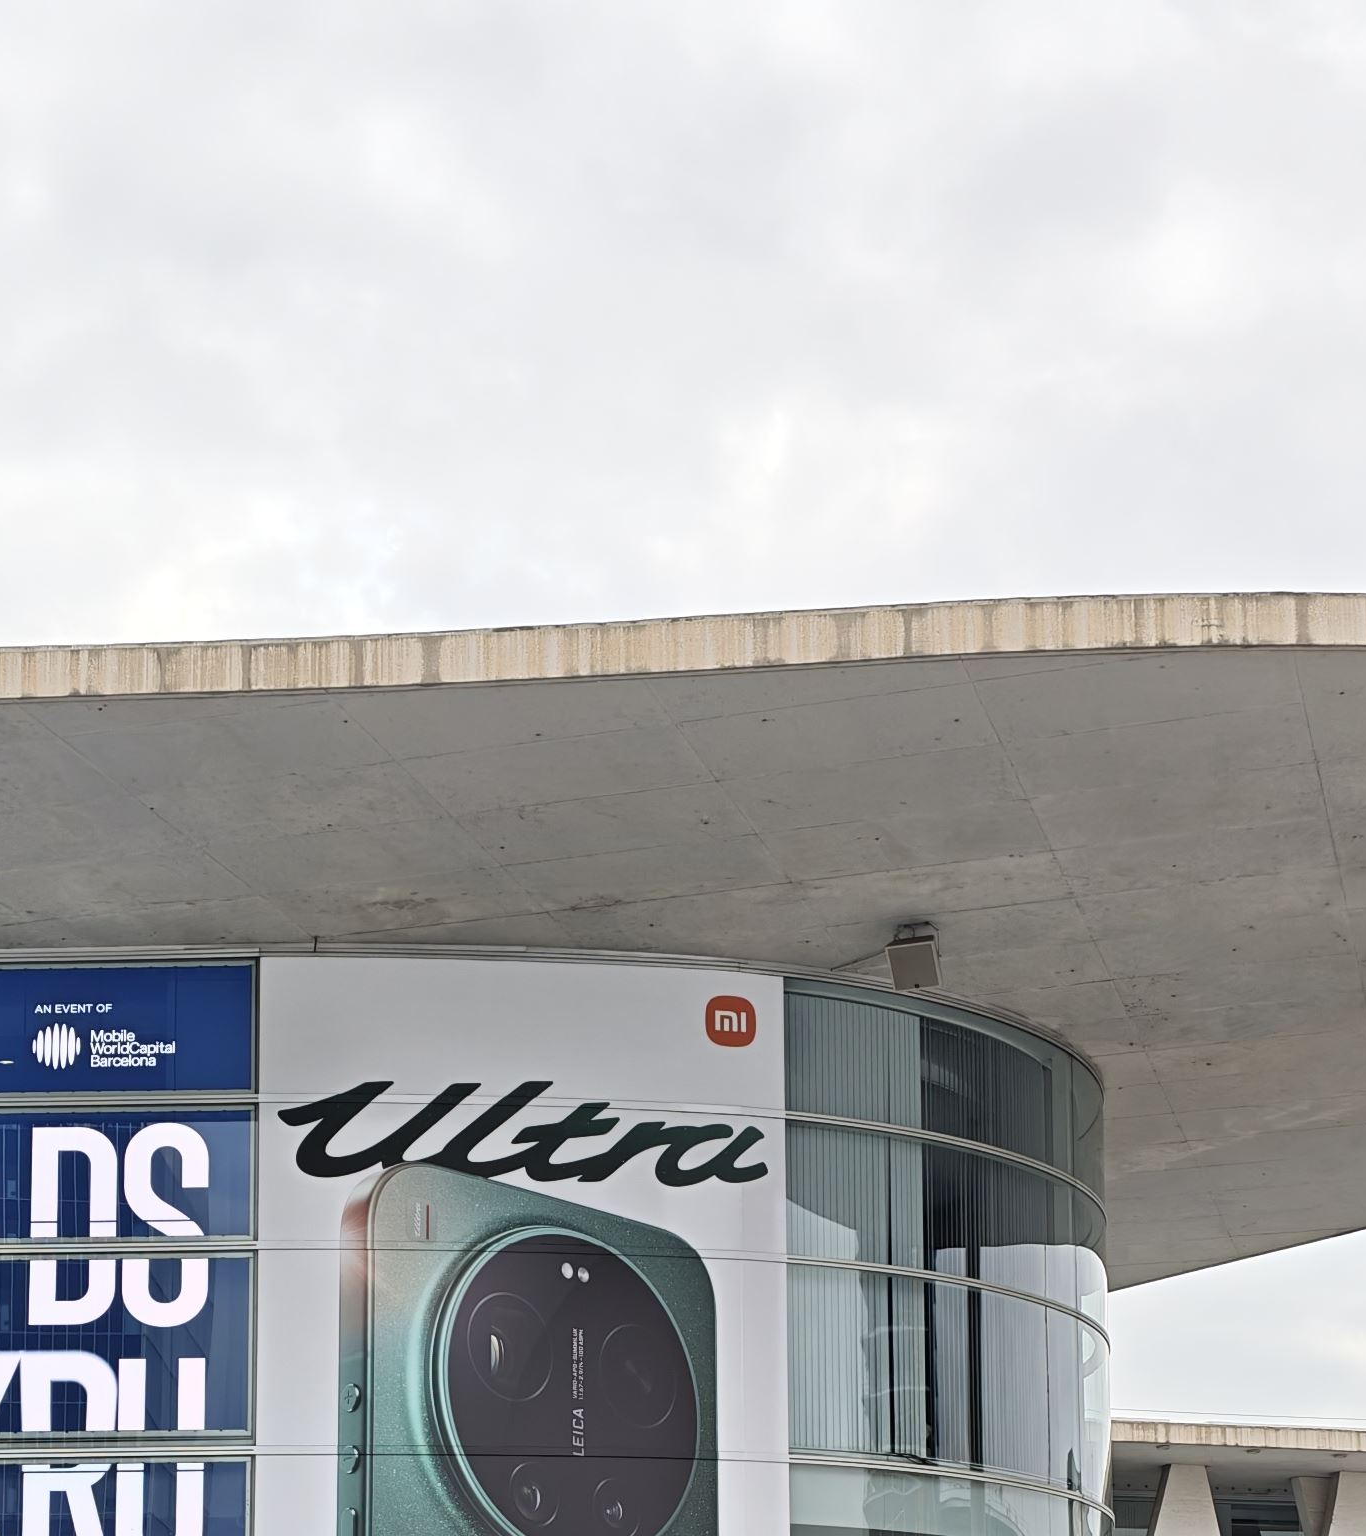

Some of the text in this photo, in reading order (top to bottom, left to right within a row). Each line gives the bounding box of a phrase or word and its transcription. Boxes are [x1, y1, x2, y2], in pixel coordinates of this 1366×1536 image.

[34, 1003, 113, 1014] AN EVENT OF
[90, 1029, 136, 1042] Mobile
[90, 1041, 176, 1056] WorldCapital
[90, 1055, 157, 1067] Barcelona
[277, 1080, 769, 1187] Ultra
[572, 1408, 585, 1457] LEICA
